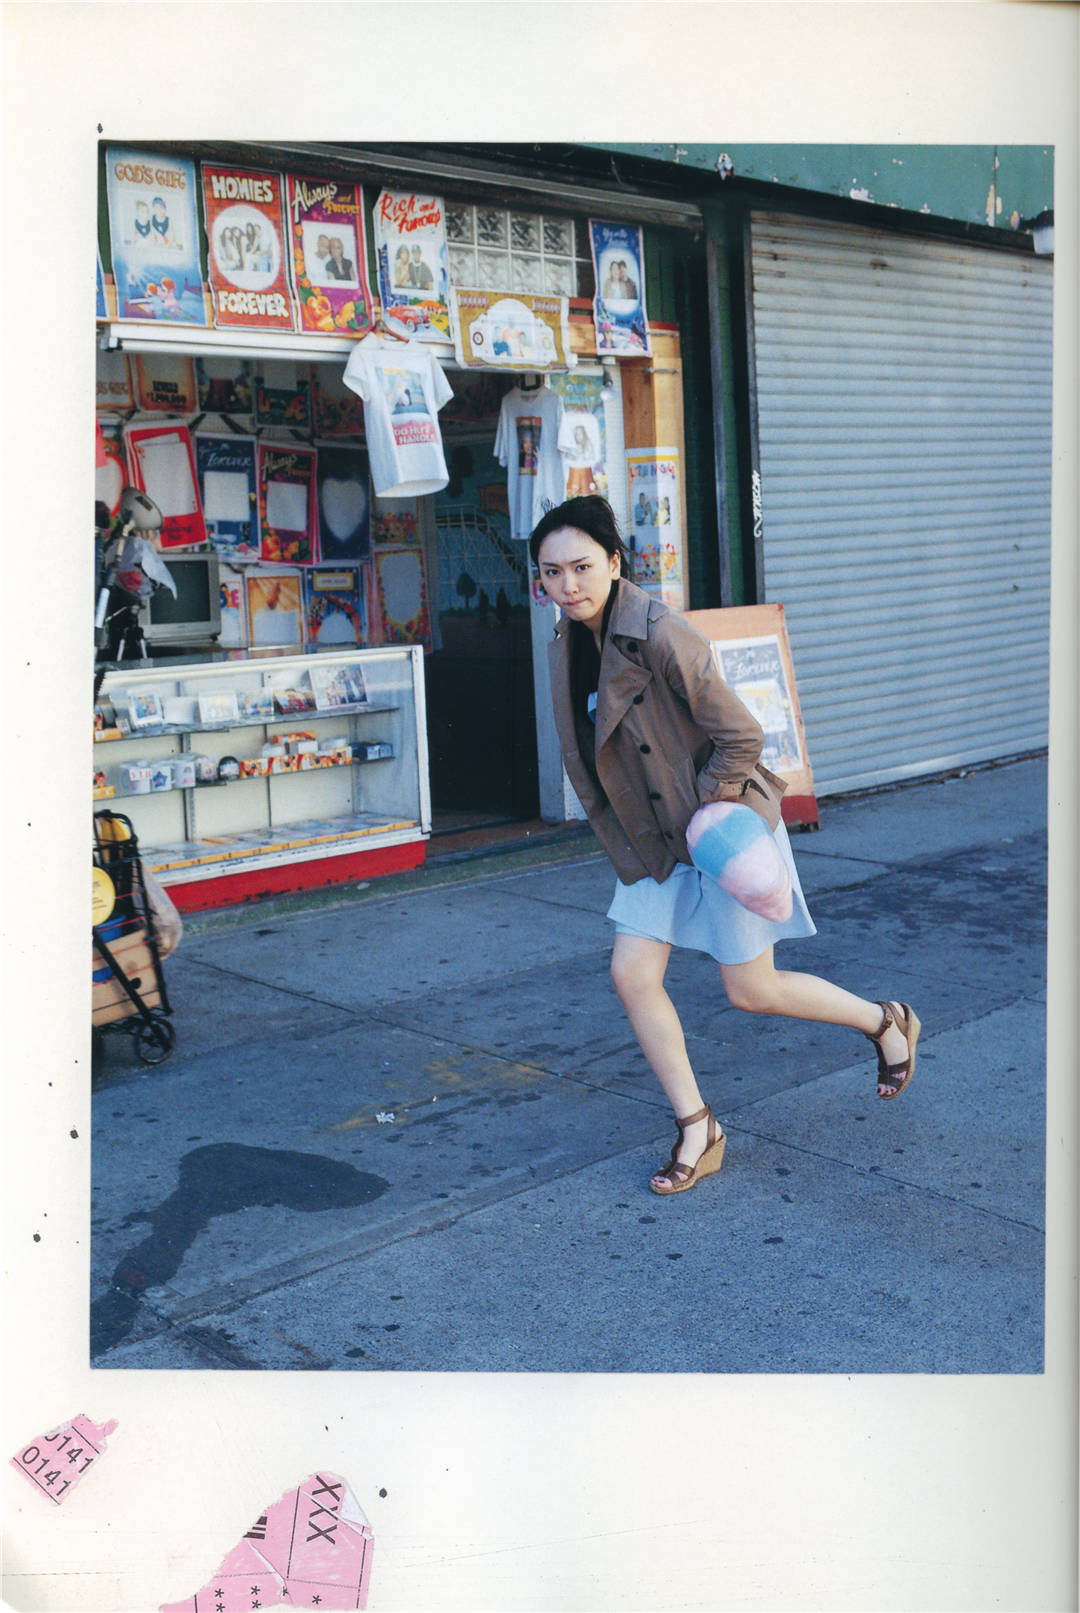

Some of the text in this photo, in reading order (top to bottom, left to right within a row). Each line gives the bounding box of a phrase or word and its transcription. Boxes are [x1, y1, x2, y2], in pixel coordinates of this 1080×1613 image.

[211, 175, 273, 202] HOMIES
[291, 180, 338, 224] Always
[380, 193, 416, 227] Rich
[218, 290, 289, 318] FOREVER
[21, 1446, 72, 1497] 0141
